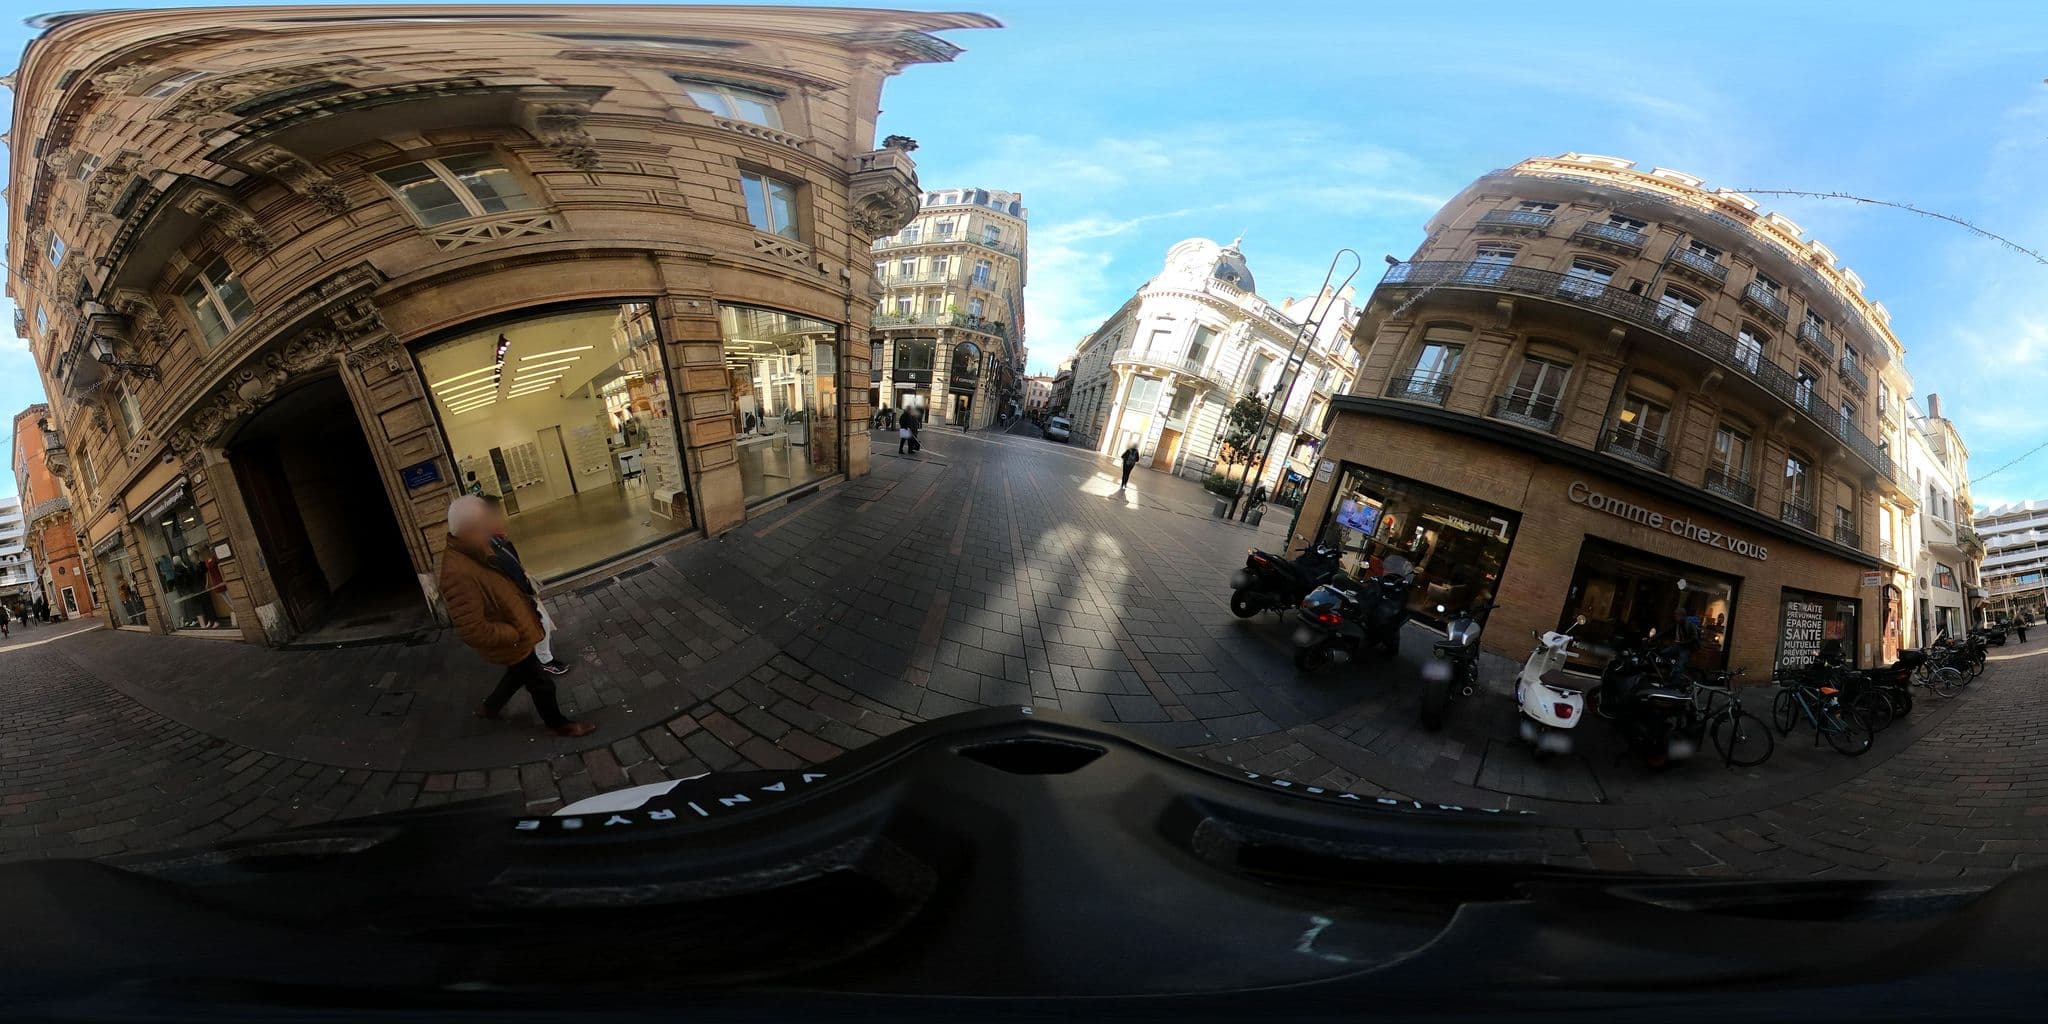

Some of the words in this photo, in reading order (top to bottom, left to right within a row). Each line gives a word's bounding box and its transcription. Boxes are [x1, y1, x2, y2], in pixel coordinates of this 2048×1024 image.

[1567, 480, 1664, 529] Comme
[1670, 517, 1722, 548] chez
[1727, 536, 1769, 561] vous
[1784, 640, 1821, 649] MUTUELLE
[1782, 655, 1816, 666] OPTIQU
